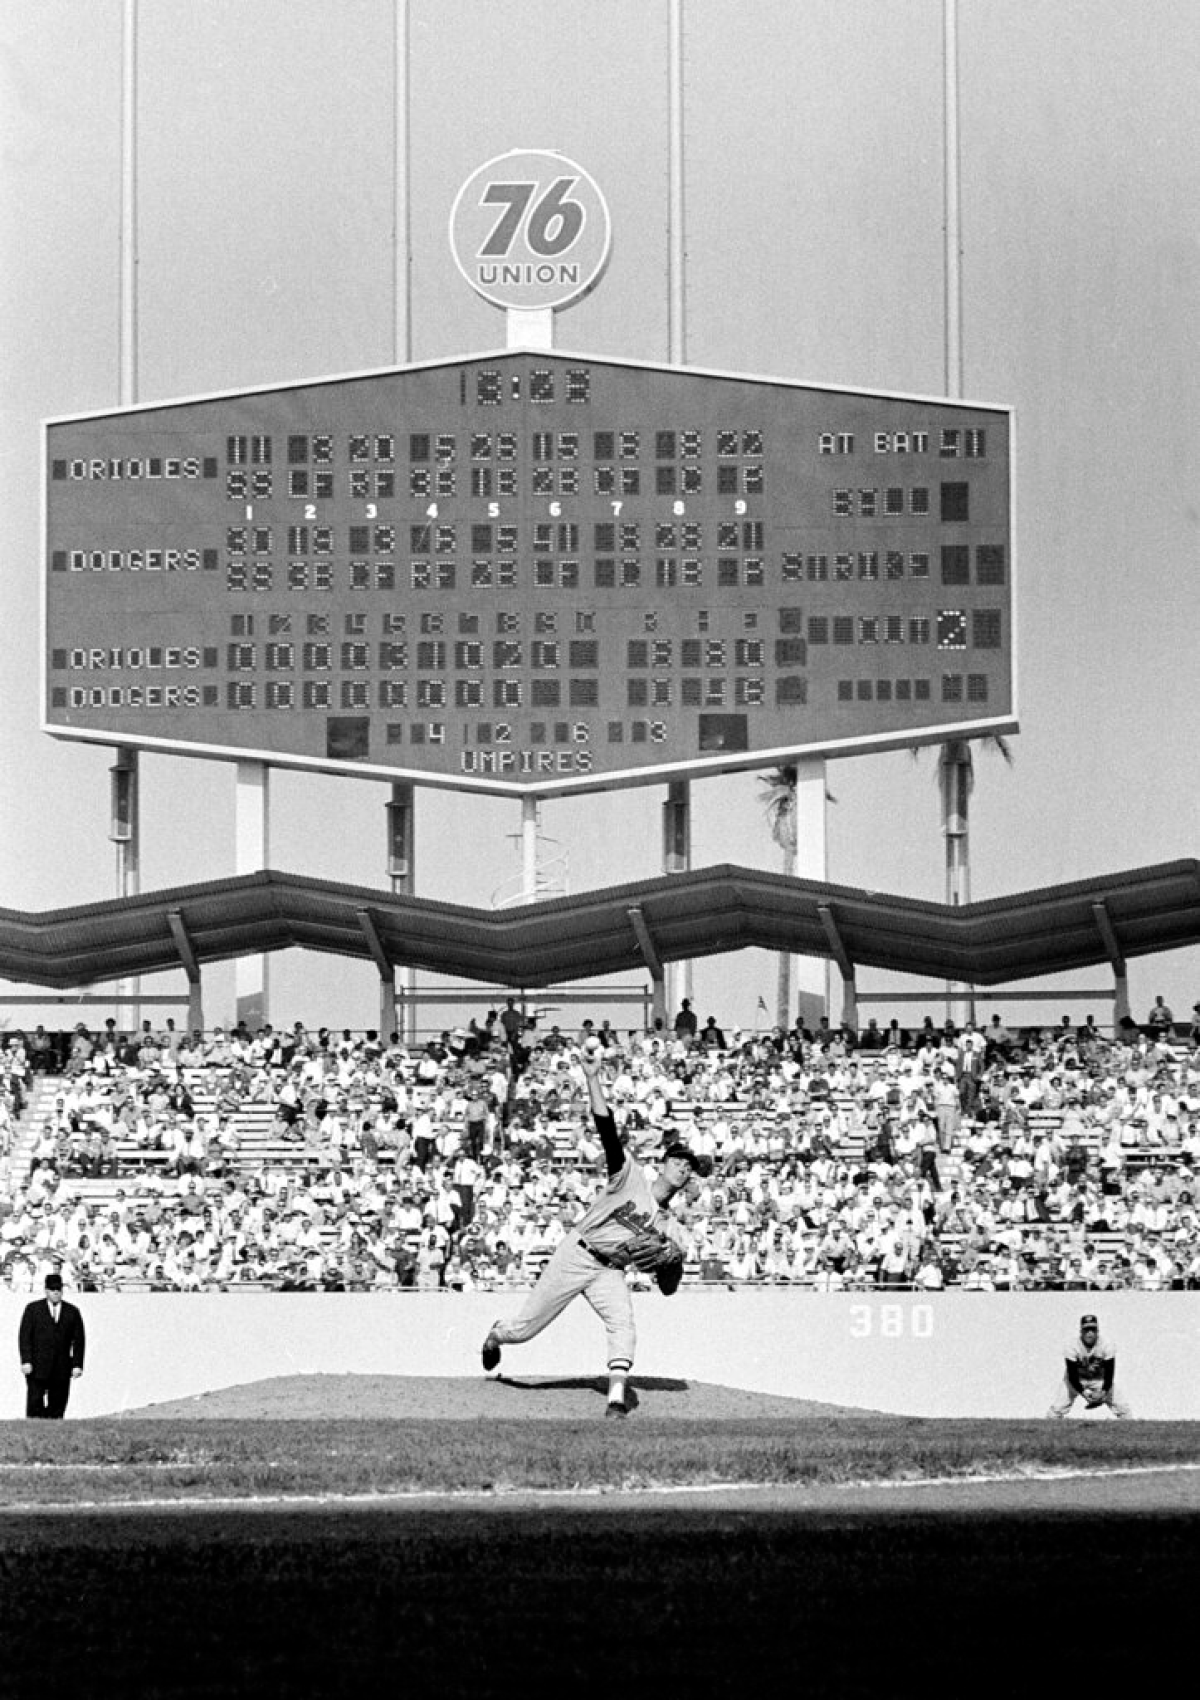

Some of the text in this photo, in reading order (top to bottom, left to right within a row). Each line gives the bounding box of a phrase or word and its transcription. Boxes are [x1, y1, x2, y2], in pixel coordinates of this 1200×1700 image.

[476, 176, 586, 258] 76
[478, 264, 581, 285] UNION
[231, 431, 763, 463] 11 3 20 5 26 15 6 8 22
[818, 429, 982, 457] AT BAT 41
[70, 458, 200, 480] ORIOLES
[227, 466, 763, 499] SS LF RF 3B 1B 2B CF C P
[245, 499, 746, 520] 1 2 3 4 5 6 7 8 9
[831, 488, 929, 517] BALL
[227, 522, 759, 555] 30 19 3 6 5 41 8 28 21
[70, 550, 201, 571] DODGERS
[227, 559, 764, 590] SS 3B CF RF 2B LF C 1B P
[782, 551, 929, 581] STRIKE
[937, 610, 966, 650] 2
[70, 647, 200, 670] ORIOLES
[236, 643, 257, 671] 0
[274, 643, 294, 670] 0
[311, 643, 332, 670] 0
[349, 642, 371, 670] 0
[387, 642, 409, 670] 3
[463, 642, 484, 669] 0
[502, 641, 522, 669] 2
[539, 641, 560, 669] 0
[651, 640, 672, 667] 6
[706, 640, 727, 667] 8
[744, 639, 765, 667] 0
[70, 685, 201, 708] DODGERS
[236, 678, 765, 709] 0 0 0 0 0 0 0 0 0 4 6
[429, 721, 667, 744] 4 2 6 3
[460, 752, 593, 773] UMPIRES
[849, 1304, 934, 1338] 380
